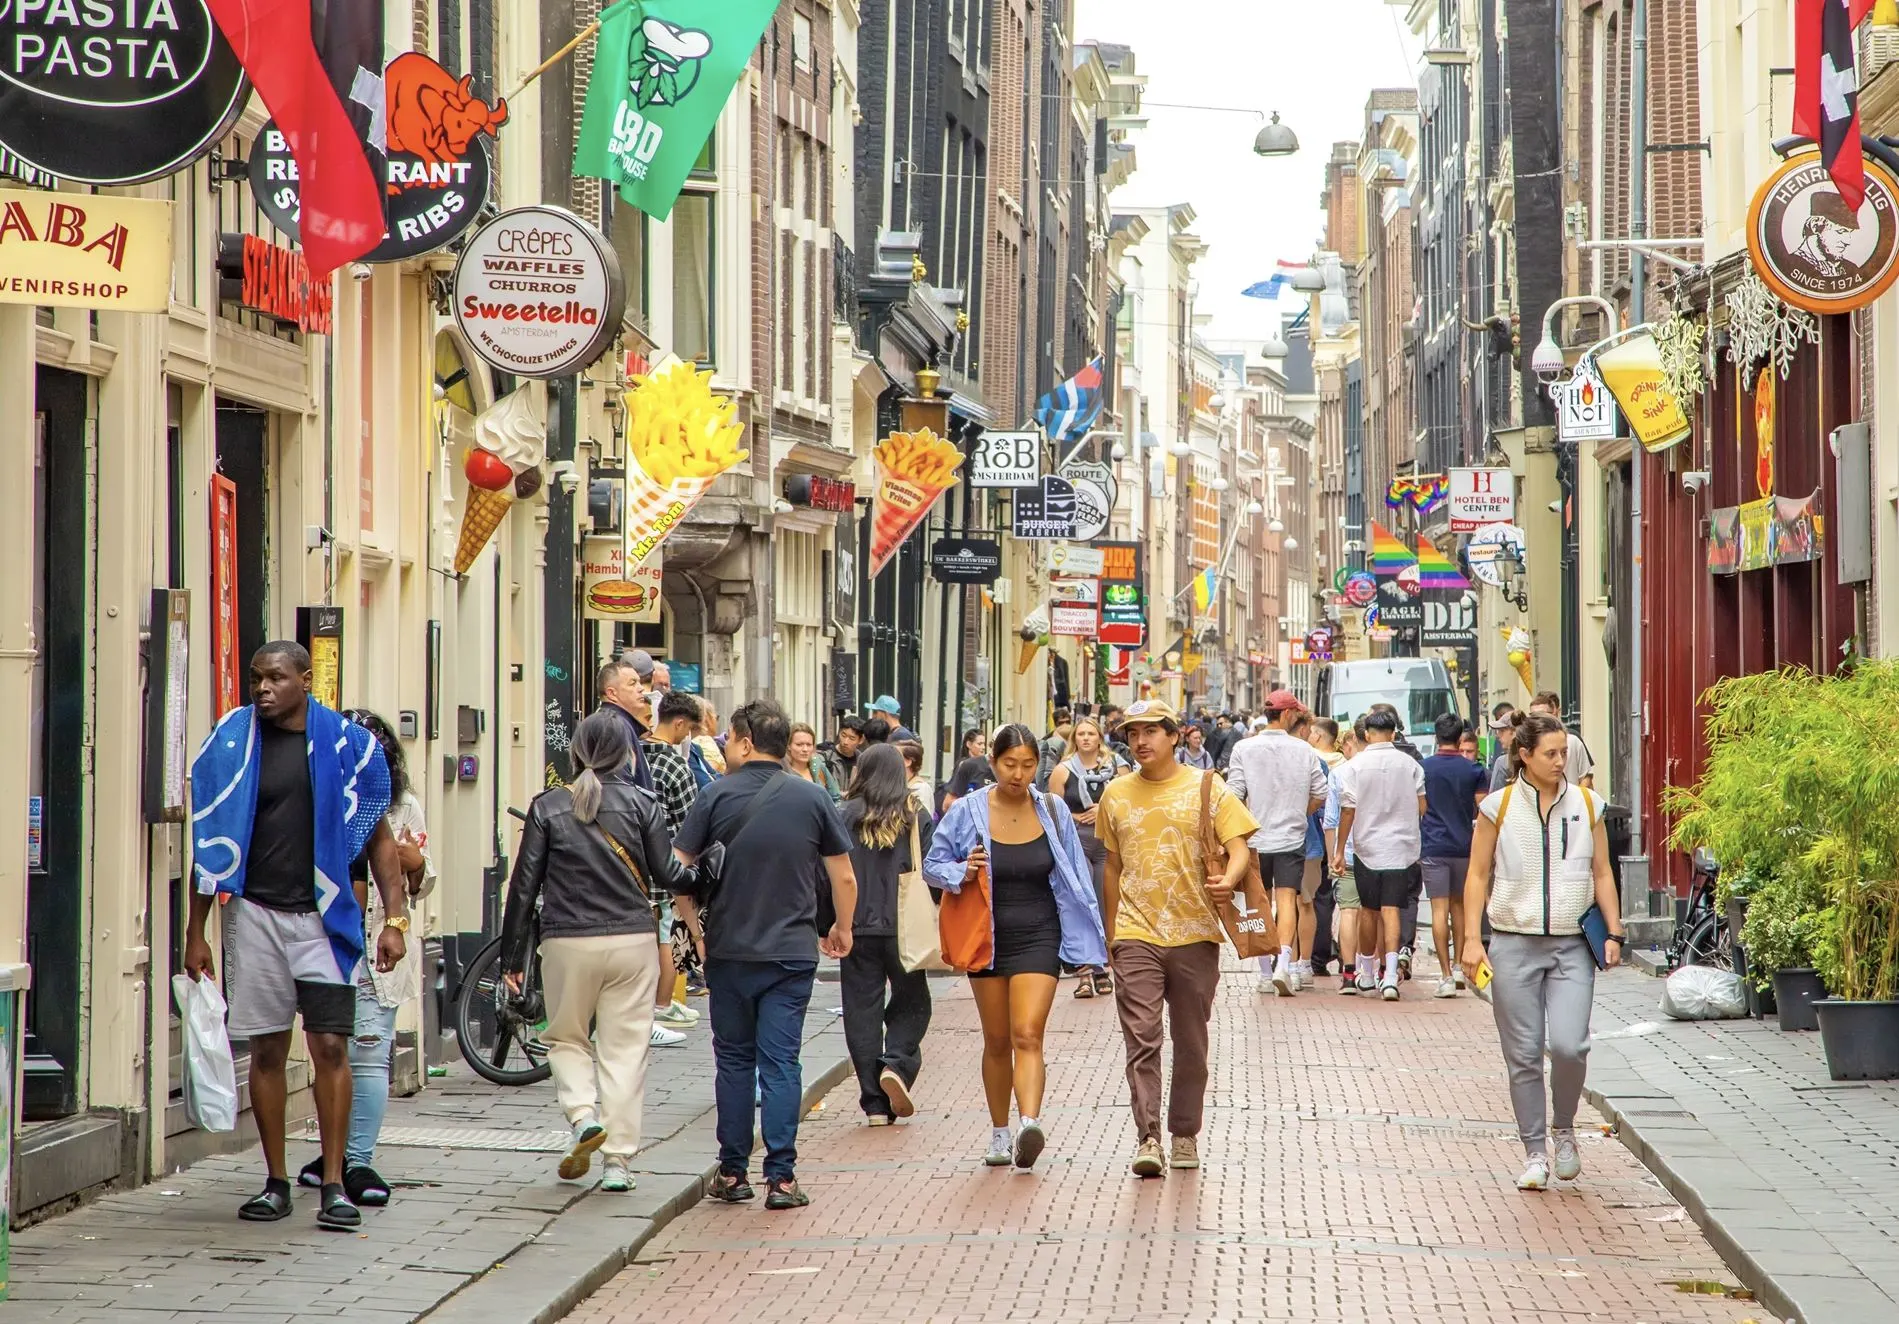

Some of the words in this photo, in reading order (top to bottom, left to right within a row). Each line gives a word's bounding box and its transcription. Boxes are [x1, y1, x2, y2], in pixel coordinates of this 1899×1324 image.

[16, 0, 180, 31] PASTA
[16, 34, 180, 80] PASTA
[398, 190, 465, 242] RIBS
[483, 259, 584, 275] WAFFLES
[1790, 268, 1826, 290] SINCE
[1830, 273, 1863, 290] 1974
[489, 279, 576, 294] CHURROS
[463, 295, 597, 325] Sweetella
[501, 327, 558, 338] AMSTERDAM
[480, 330, 493, 347] WE
[492, 344, 543, 364] CHOCOLIZE
[544, 338, 578, 363] THINGS
[1570, 403, 1606, 423] NOT
[1645, 427, 1662, 438] BAR
[1066, 470, 1103, 478] ROUTE
[1455, 496, 1487, 504] HOTEL
[631, 536, 657, 561] Mr.
[651, 501, 685, 534] Tom
[1021, 519, 1070, 530] BURGER
[1452, 522, 1475, 530] CHEAP
[1021, 529, 1070, 537] FABRIEK
[1053, 625, 1094, 633] SOUVENIRS
[1423, 632, 1473, 640] AMSTERDAM
[1309, 652, 1333, 660] ATM
